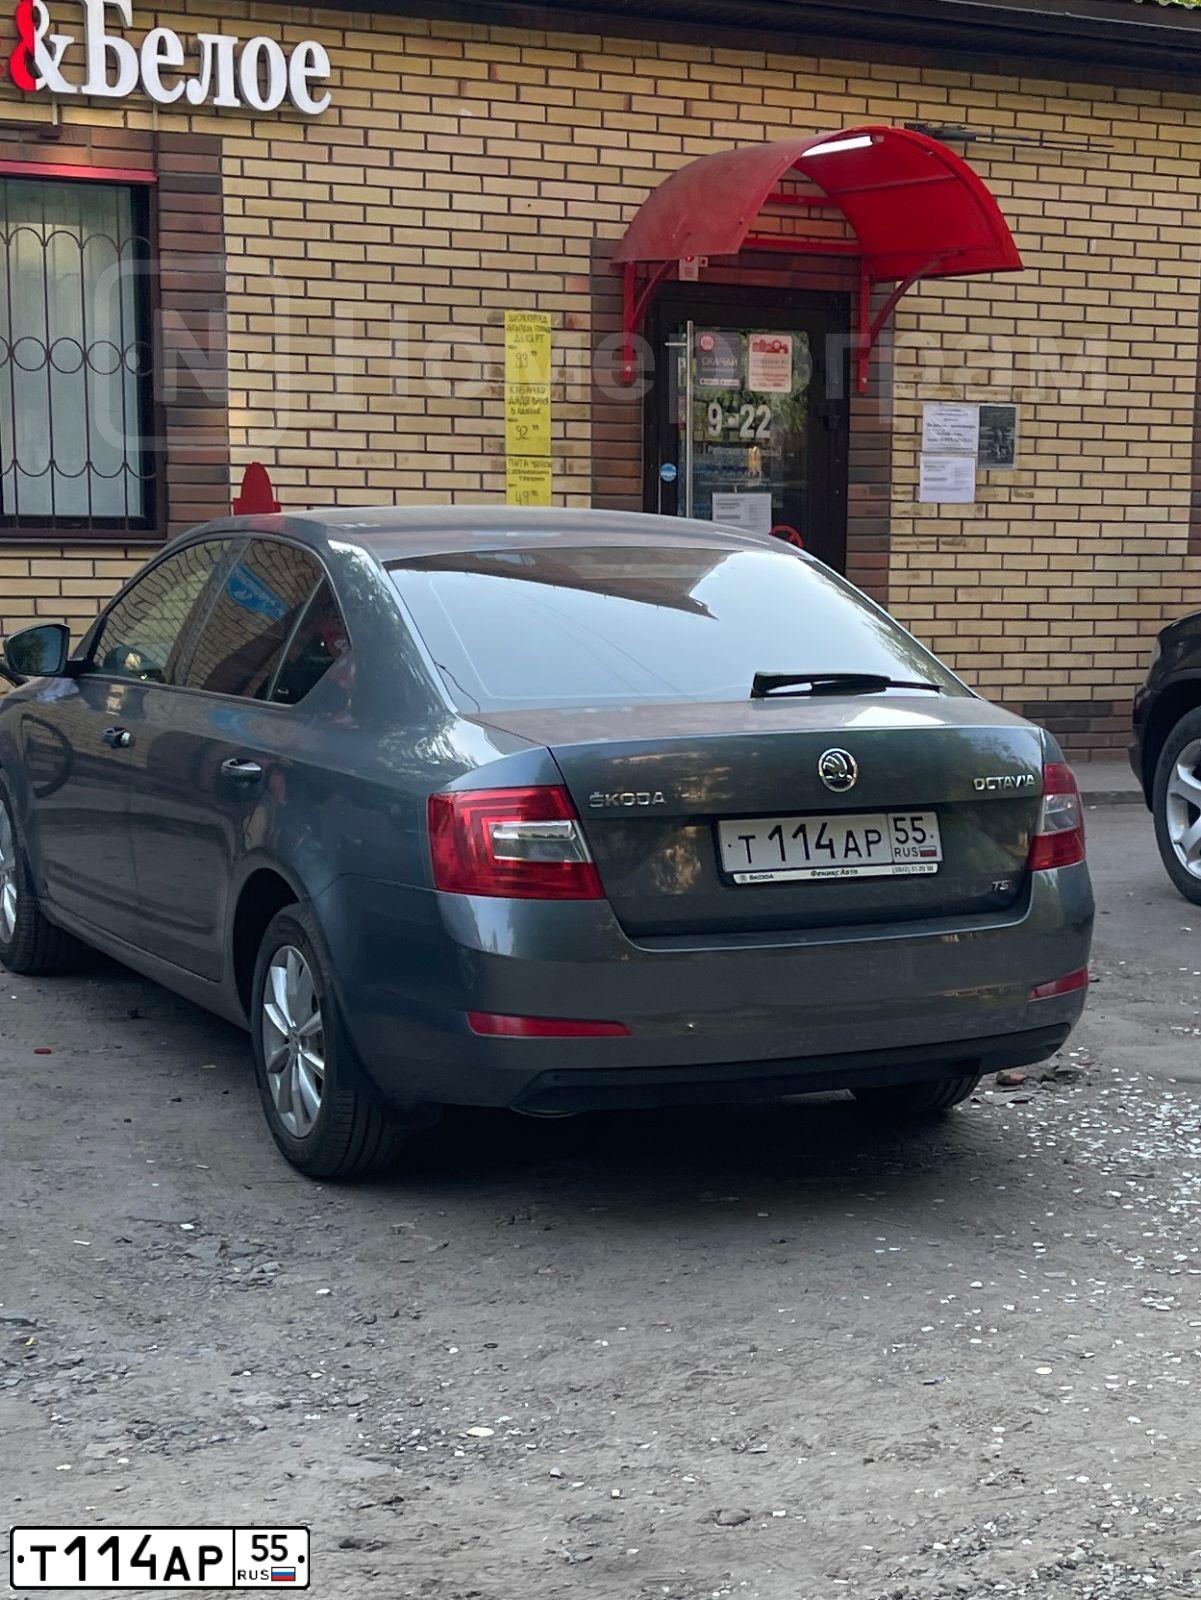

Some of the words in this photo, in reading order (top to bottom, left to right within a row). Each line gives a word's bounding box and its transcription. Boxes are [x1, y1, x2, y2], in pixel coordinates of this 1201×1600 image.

[708, 401, 771, 438] 9-22
[973, 774, 1036, 791] OCTAVIA
[893, 816, 927, 845] 55
[894, 846, 919, 858] RUS
